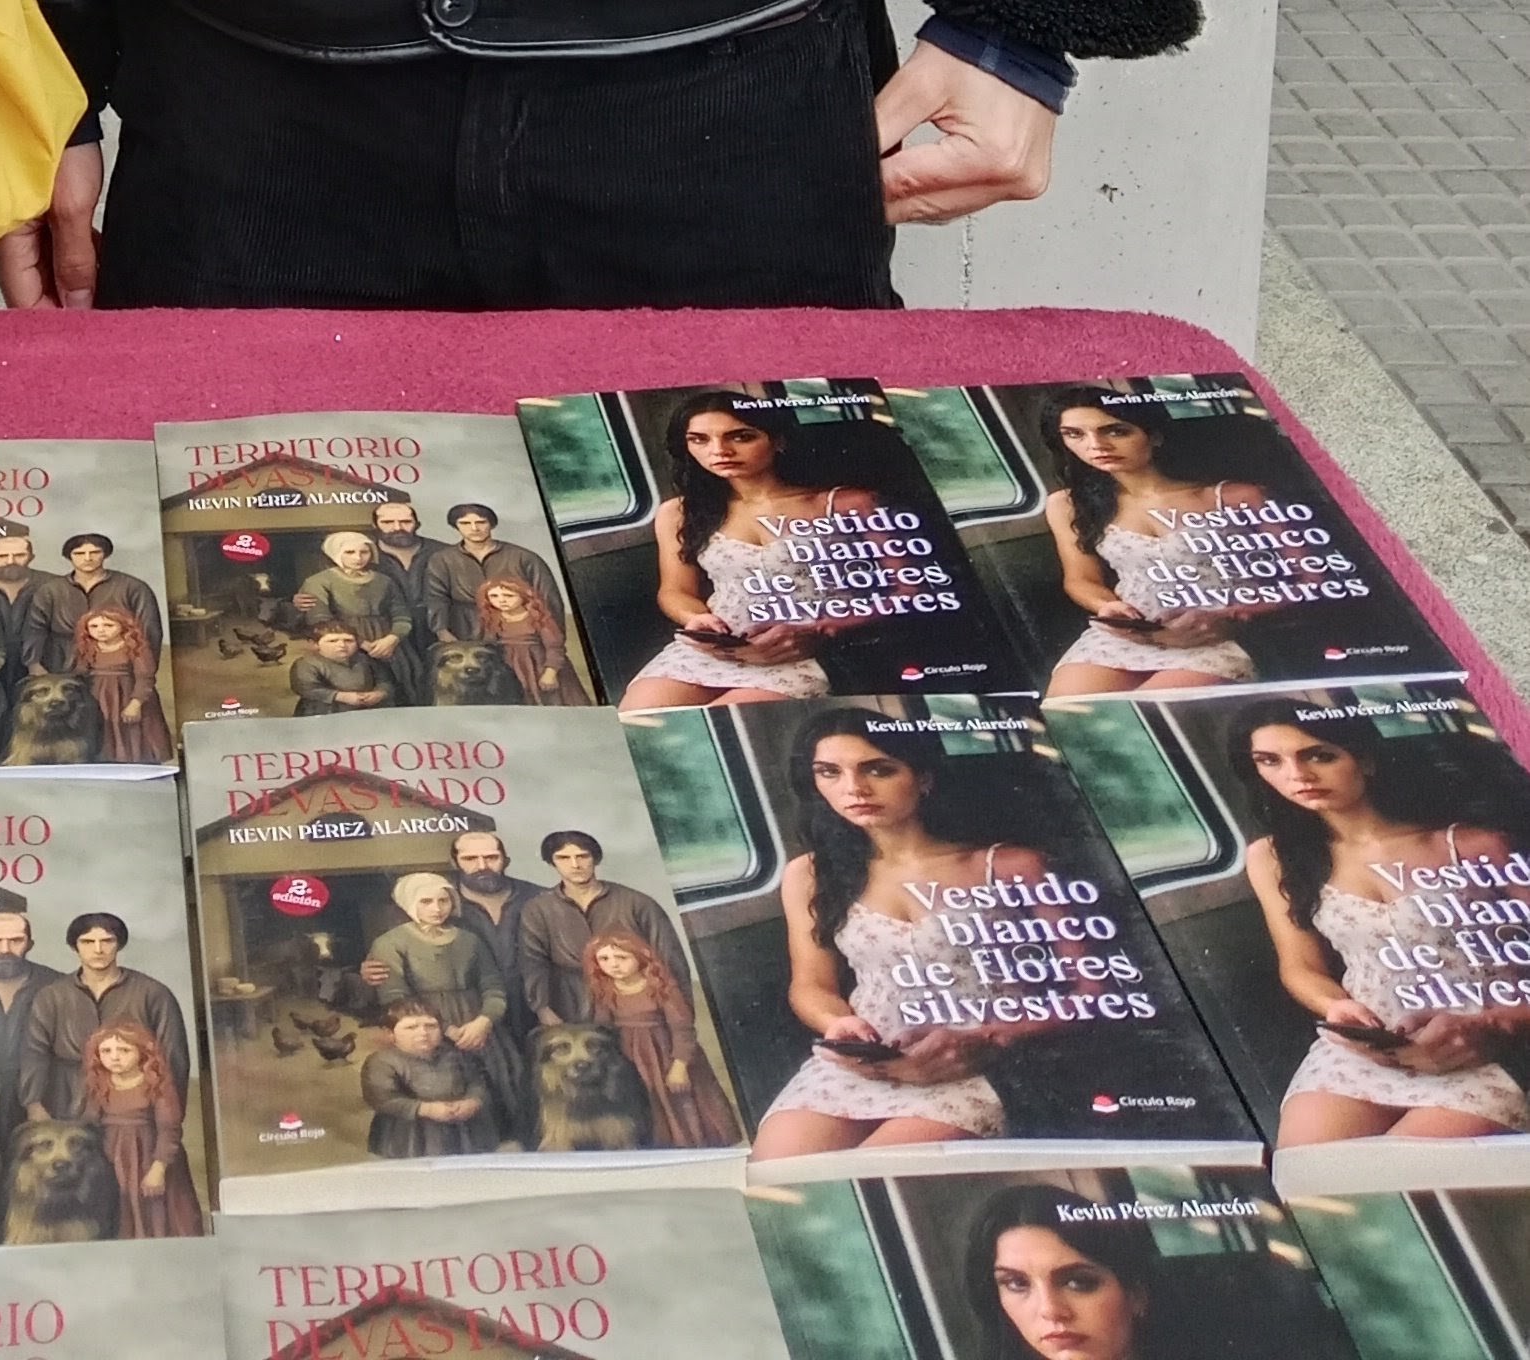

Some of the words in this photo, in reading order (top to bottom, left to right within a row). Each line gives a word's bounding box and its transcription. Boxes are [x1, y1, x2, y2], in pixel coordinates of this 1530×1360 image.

[732, 396, 773, 410] Kevin
[817, 392, 870, 406] Alarcón
[1101, 392, 1141, 406] Kevin
[1184, 387, 1239, 402] Alarcón
[184, 437, 421, 466] TERRITORIO
[189, 463, 420, 491] DEVASTADO
[189, 495, 241, 511] KEVIN
[246, 492, 303, 507] PÉREZ
[306, 489, 389, 505] ALARCÓN
[1147, 500, 1313, 531] Vestido
[757, 507, 920, 538] Vestido
[785, 537, 933, 564] blanco
[1180, 527, 1331, 555] blanco
[742, 569, 796, 595] de
[809, 561, 950, 591] flores
[1146, 560, 1201, 583] de
[1211, 551, 1353, 580] flores
[748, 591, 962, 623] silvestres
[1157, 577, 1370, 609] silvestres
[866, 719, 914, 734] Kevin
[965, 716, 1028, 732] Alarcón
[1295, 707, 1345, 722] Kevin
[1396, 698, 1459, 713] Alarcón
[221, 740, 506, 782] TERRITORIO
[227, 777, 507, 818] DEVASTADO
[229, 825, 293, 845] KEVIN
[299, 820, 366, 839] PÉREZ
[370, 813, 469, 835] ALARCÓN
[1370, 853, 1530, 892] Vestid
[904, 873, 1100, 912] Vestido
[1413, 892, 1530, 928] blan
[940, 913, 1118, 947] blanco
[1378, 937, 1444, 971] de
[1456, 930, 1530, 968] flo
[891, 954, 956, 989] de
[971, 948, 1139, 986] flores
[899, 989, 1157, 1026] silvestres
[1395, 974, 1530, 1010] silves
[1056, 1201, 1117, 1222] Kevin
[1180, 1197, 1260, 1217] Alarcón
[258, 1243, 608, 1307] TERRITORIO
